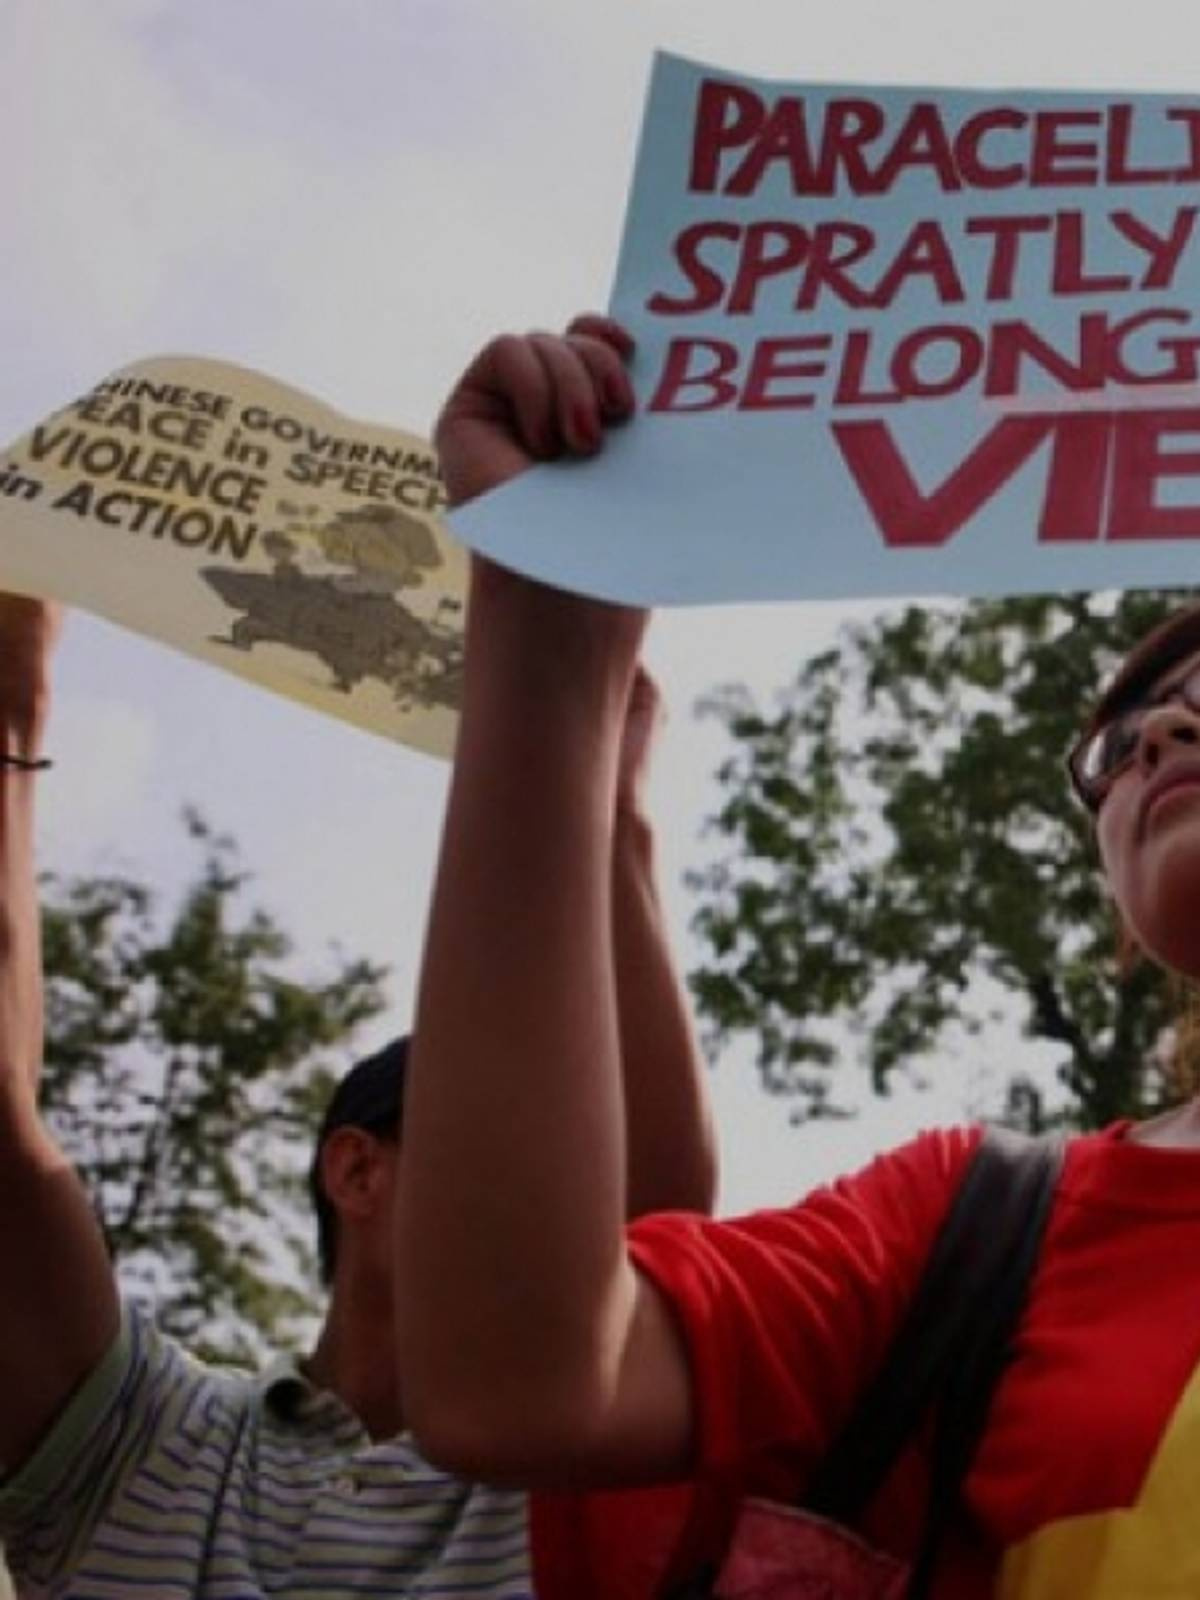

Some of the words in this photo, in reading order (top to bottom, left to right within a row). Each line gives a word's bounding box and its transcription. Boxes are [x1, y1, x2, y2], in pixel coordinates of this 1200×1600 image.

[687, 78, 1173, 197] PARACEL
[646, 205, 1199, 317] SPRATLY
[28, 425, 268, 514] VIOLENCE
[70, 396, 214, 450] EACE
[224, 427, 268, 469] in
[0, 463, 43, 501] in
[51, 480, 258, 560] ACTION
